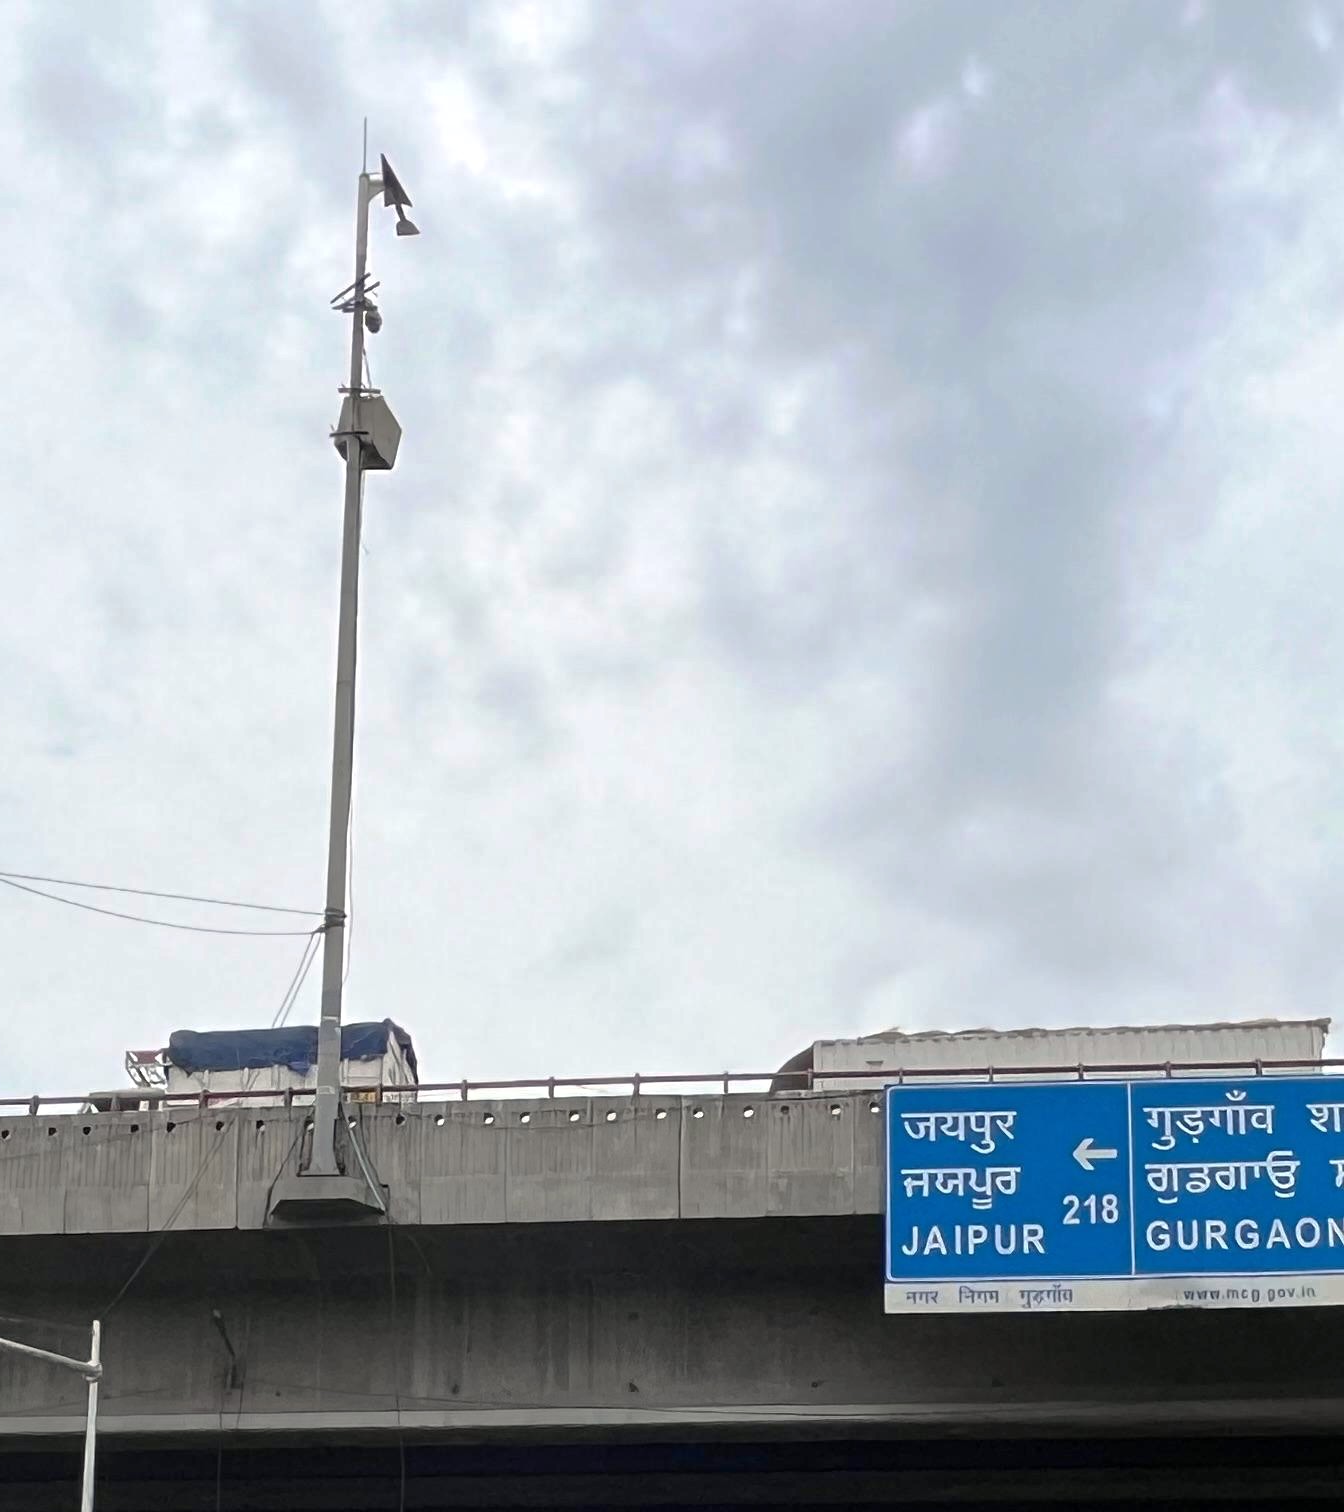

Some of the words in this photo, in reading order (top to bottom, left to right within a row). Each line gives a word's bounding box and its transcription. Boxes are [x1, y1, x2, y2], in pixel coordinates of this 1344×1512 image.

[901, 1111, 1017, 1154] जयपुर
[1143, 1090, 1274, 1150] गुड़गाँव
[1063, 1194, 1119, 1225] 218
[902, 1224, 1046, 1256] JAIPUR
[906, 1290, 940, 1305] नगर
[959, 1286, 1000, 1304] निगम
